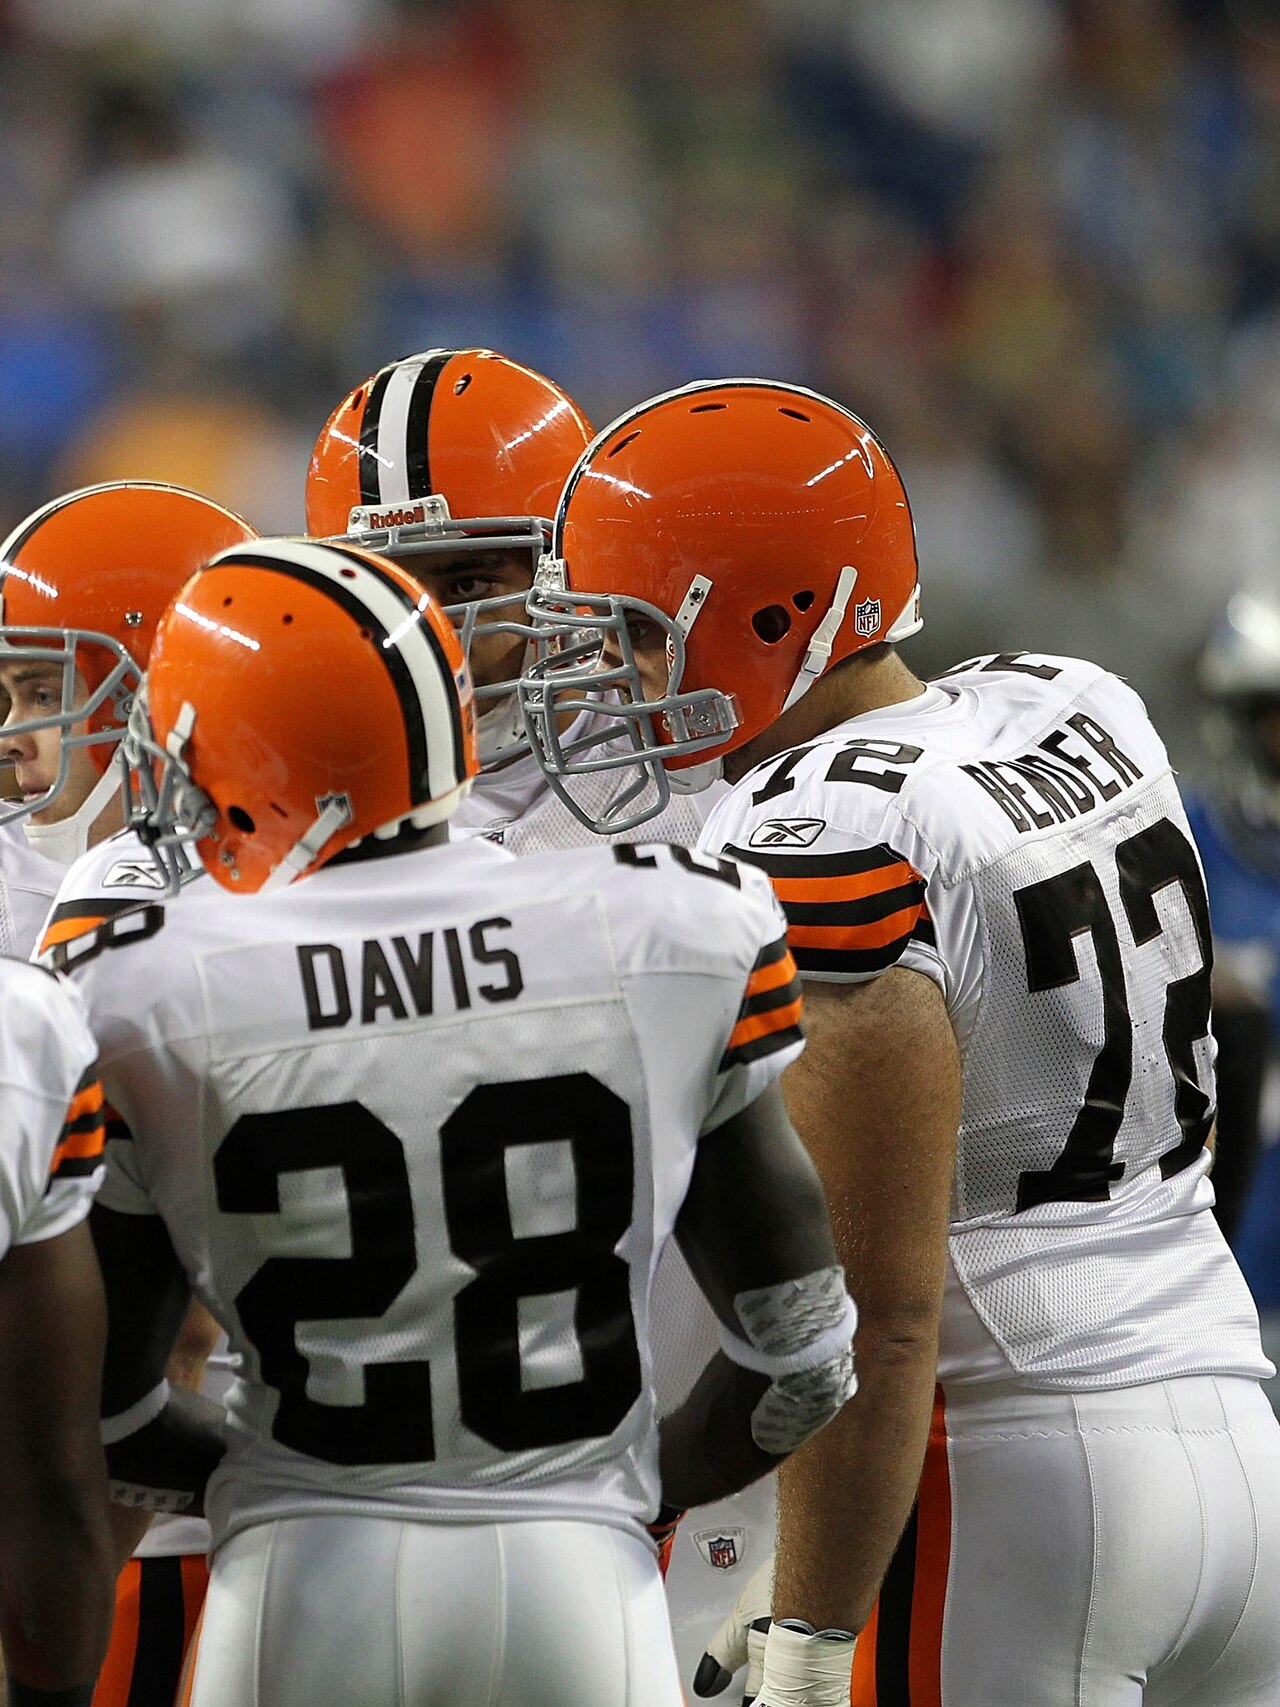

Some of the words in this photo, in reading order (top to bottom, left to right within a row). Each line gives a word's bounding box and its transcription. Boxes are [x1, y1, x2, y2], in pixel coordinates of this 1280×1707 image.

[369, 506, 425, 530] Riddell
[858, 614, 878, 631] NFL
[751, 739, 925, 807] 72
[959, 712, 1143, 834] BENDER
[296, 916, 524, 1031] DAVIS
[1013, 817, 1215, 1210] 72
[213, 1071, 642, 1467] 28
